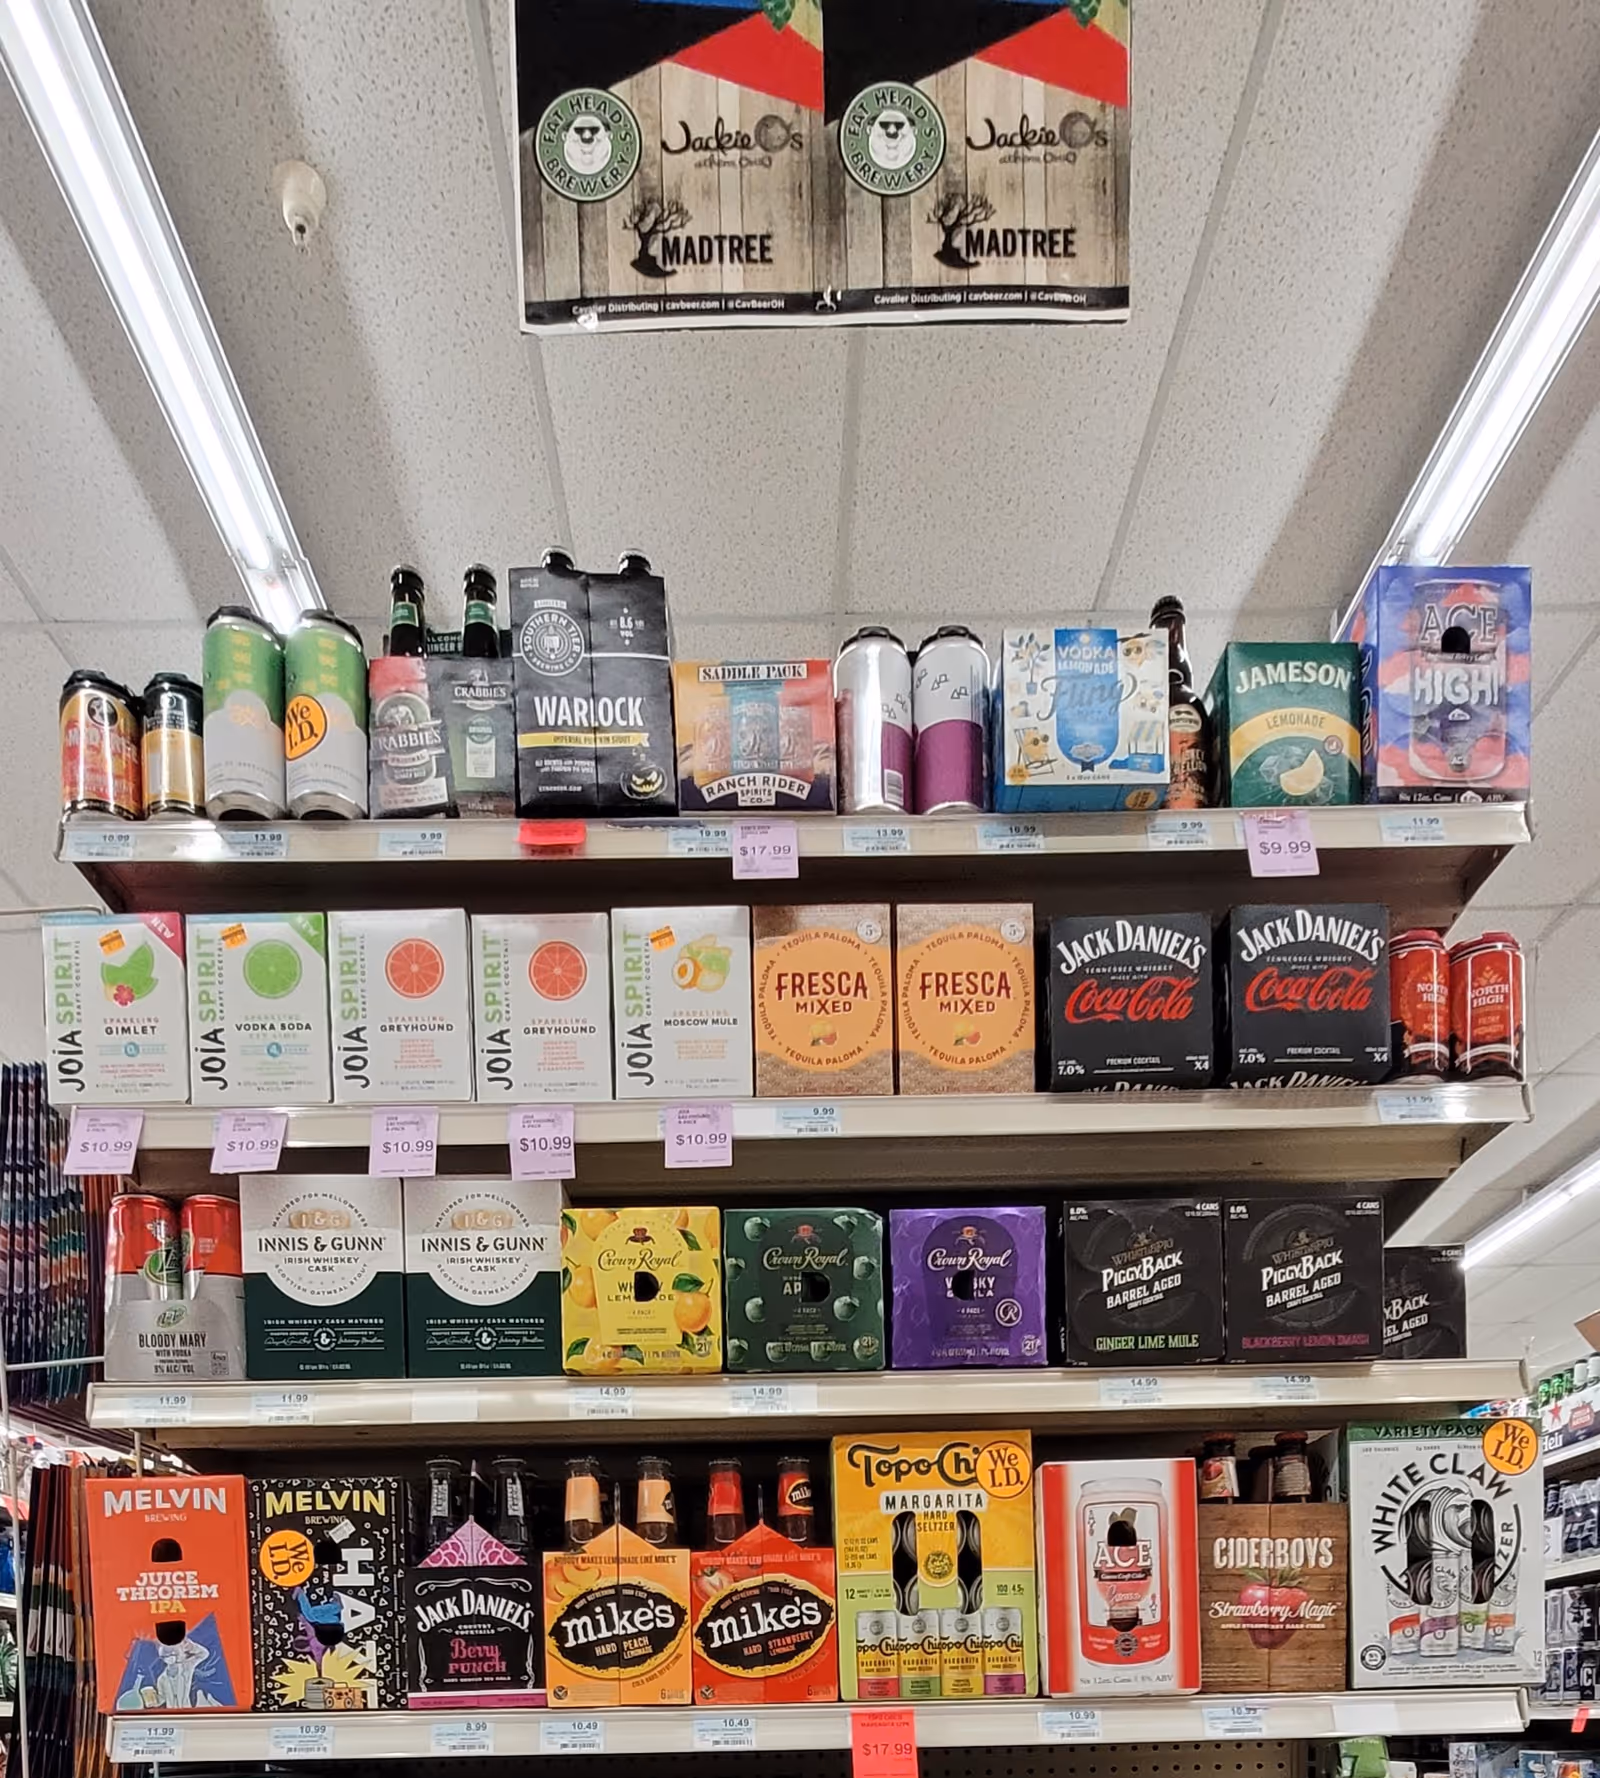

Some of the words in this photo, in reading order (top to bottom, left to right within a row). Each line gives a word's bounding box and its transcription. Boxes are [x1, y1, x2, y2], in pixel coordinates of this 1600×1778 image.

[543, 111, 567, 145] FAT
[569, 94, 633, 145] HEAD'S
[849, 106, 871, 138] FAT
[874, 87, 938, 140] HEAD'S
[662, 118, 755, 155] Jackie
[966, 117, 1059, 153] Jackie
[545, 158, 627, 195] BREWERY
[849, 152, 932, 188] BREWERY
[662, 235, 773, 265] MADTREE
[966, 228, 1076, 258] MADTREE
[608, 302, 659, 313] Distributing
[667, 300, 719, 310] cavbeer.com
[521, 614, 568, 652] SOUTHERN
[568, 620, 583, 652] TIER
[1058, 647, 1114, 660] VODKA
[702, 666, 755, 680] SADDLE
[761, 664, 803, 679] PACK
[1236, 662, 1351, 694] JAMESON
[1415, 666, 1499, 705] HIGH
[535, 696, 643, 728] WARLOCK
[1267, 715, 1324, 729] LEMONADE
[706, 775, 758, 800] RANCH
[762, 775, 806, 797] RIDER
[739, 844, 791, 856] $17.99
[1259, 841, 1312, 855] $9.99
[151, 918, 175, 939] NEW
[1236, 922, 1292, 963] JACK
[1295, 909, 1384, 962] DANIEL'S
[1056, 923, 1114, 976] JACK
[1116, 920, 1207, 971] DANIEL'S
[54, 938, 75, 1024] SPIRIT
[776, 972, 867, 1000] FRESCA
[920, 972, 1011, 1000] FRESCA
[1468, 986, 1509, 998] NORTH
[1065, 977, 1199, 1024] Coca-Cola
[1473, 994, 1504, 1007] HIGH
[235, 1023, 275, 1032] VODKA
[281, 1023, 311, 1031] SODA
[380, 1023, 454, 1033] GREYHOUND
[664, 1018, 708, 1027] MOSCOW
[712, 1017, 737, 1026] MULE
[105, 1026, 157, 1035] GIMLET
[524, 1026, 595, 1035] GREYHOUND
[1058, 1065, 1085, 1075] 7.0%
[813, 1108, 834, 1116] 9.99
[80, 1142, 132, 1153] $10.99
[227, 1139, 278, 1152] $10.99
[520, 1137, 571, 1152] $10.99
[676, 1133, 727, 1146] $10.99
[258, 1237, 307, 1252] INNIS
[313, 1237, 327, 1252] &
[331, 1237, 383, 1251] GUNN
[284, 1257, 310, 1265] IRISH
[313, 1256, 359, 1265] WHISKEY
[928, 1248, 966, 1269] Crown
[968, 1249, 1010, 1271] Royal
[1106, 1284, 1150, 1309] BARREL
[1153, 1273, 1181, 1294] AGED
[139, 1334, 176, 1348] BLOODY
[178, 1334, 206, 1348] MARY
[1096, 1337, 1134, 1350] GINGER
[1137, 1335, 1165, 1348] LIME
[1169, 1335, 1198, 1347] MULE
[1375, 1425, 1441, 1437] VARIETY
[1445, 1425, 1485, 1437] PACK
[1502, 1426, 1530, 1451] We
[1493, 1443, 1524, 1470] I.D.
[104, 1487, 226, 1517] MELVIN
[266, 1490, 386, 1518] MELVIN
[885, 1493, 984, 1510] MARGARITA
[1372, 1462, 1425, 1553] WHITE
[1430, 1452, 1512, 1499] CLAW
[145, 1514, 187, 1522] BREWING
[923, 1511, 947, 1521] HARD
[917, 1521, 956, 1533] SELTZER
[1213, 1537, 1333, 1569] CIDERBOYS
[135, 1572, 198, 1587] JUICE
[117, 1585, 219, 1599] THEOREM
[150, 1599, 186, 1614] IPA
[416, 1596, 459, 1632] JACK
[462, 1589, 534, 1631] DANIEL'S
[1209, 1601, 1290, 1626] Strawberry
[1294, 1600, 1335, 1622] Magic
[563, 1600, 675, 1648] mike's
[708, 1598, 821, 1647] mike's
[450, 1640, 499, 1662] Berry
[623, 1636, 649, 1651] PEACH
[449, 1661, 506, 1673] PUNCH
[465, 1722, 487, 1731] 8.99
[862, 1742, 912, 1756] $17.99
